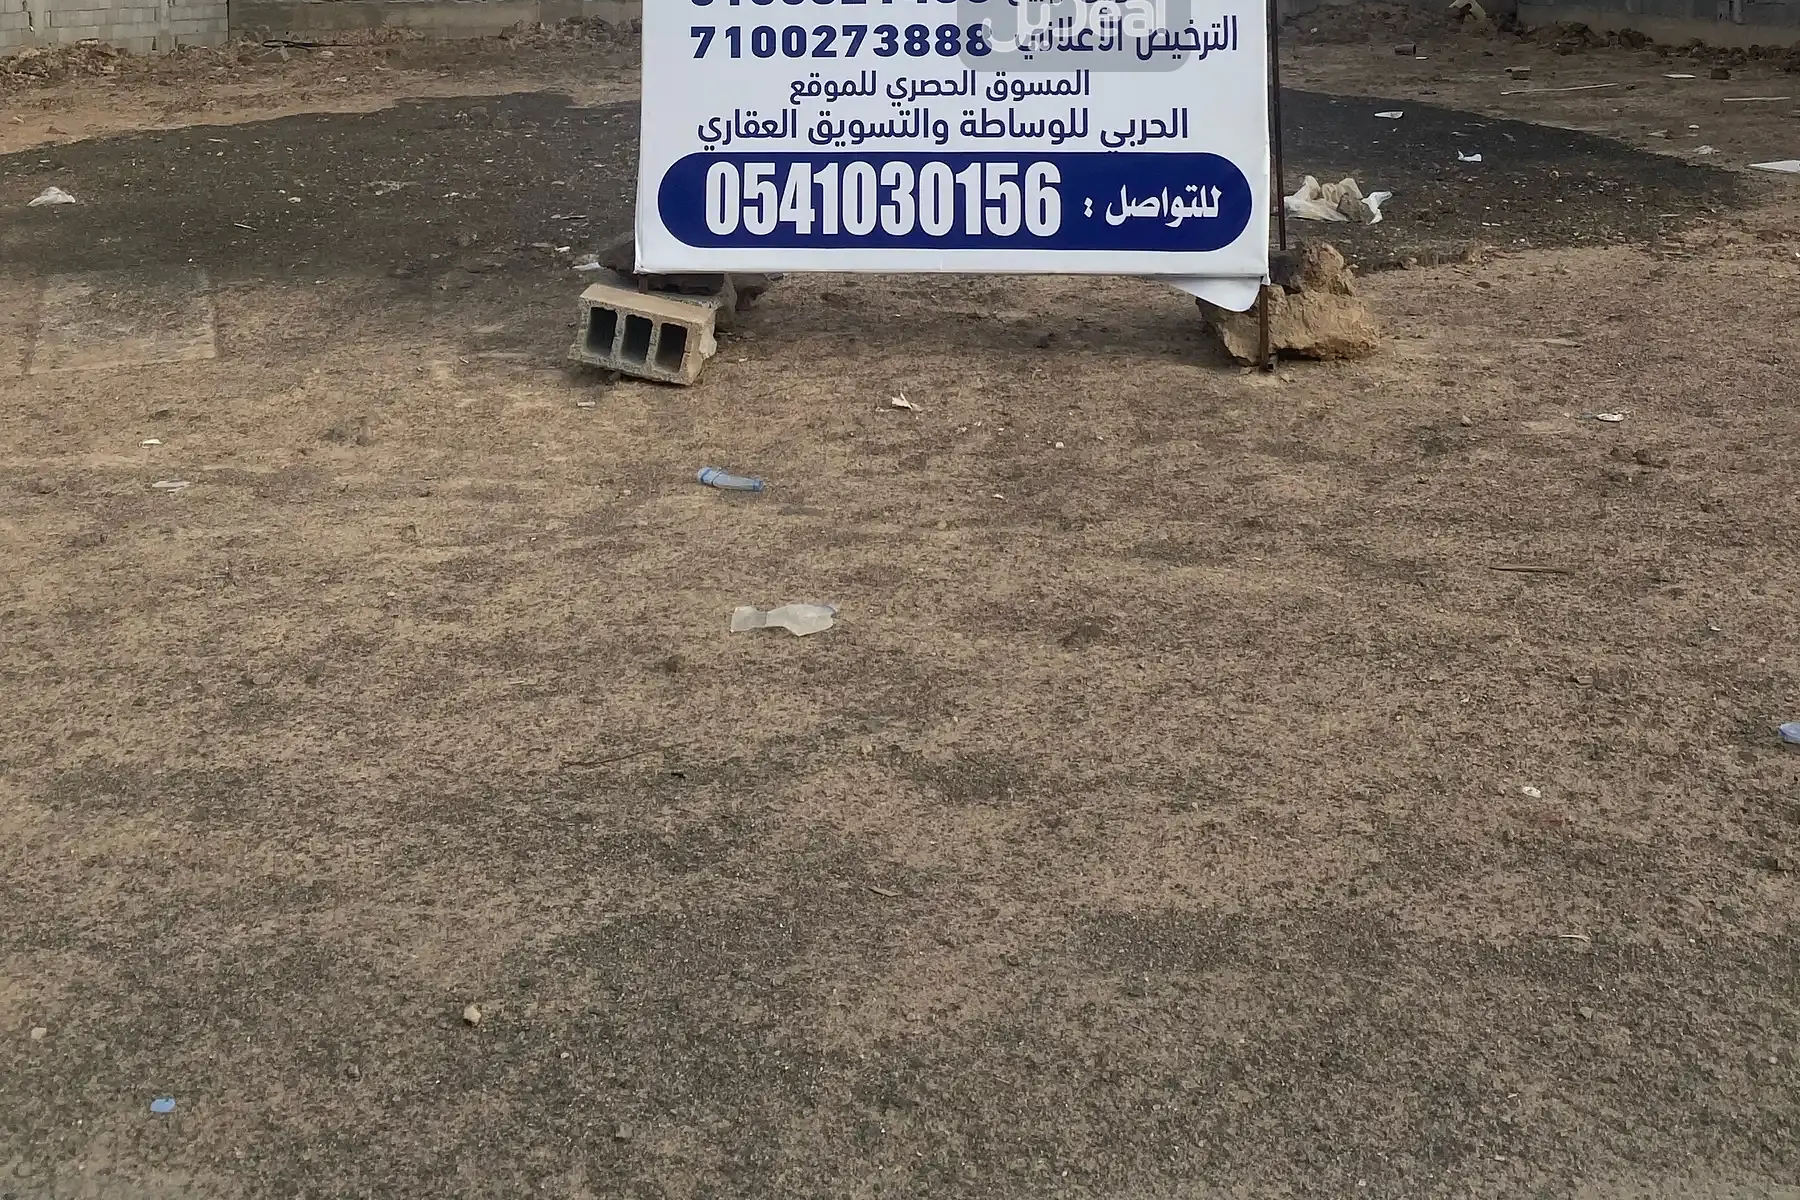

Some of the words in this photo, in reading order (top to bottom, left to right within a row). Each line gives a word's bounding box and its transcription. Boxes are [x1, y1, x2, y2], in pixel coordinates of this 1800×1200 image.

[689, 22, 993, 59] 7100273888
[1135, 15, 1238, 61] الترخيص
[789, 71, 878, 104] للموقع
[886, 71, 977, 108] الحصري
[985, 69, 1090, 105] المسوق
[697, 107, 797, 151] العقاري
[807, 106, 950, 148] والتسويق
[959, 106, 1089, 145] للوساطة
[1100, 108, 1188, 155] الحربي
[704, 160, 1063, 238] 0541030156
[1105, 183, 1223, 227] للتواصل
